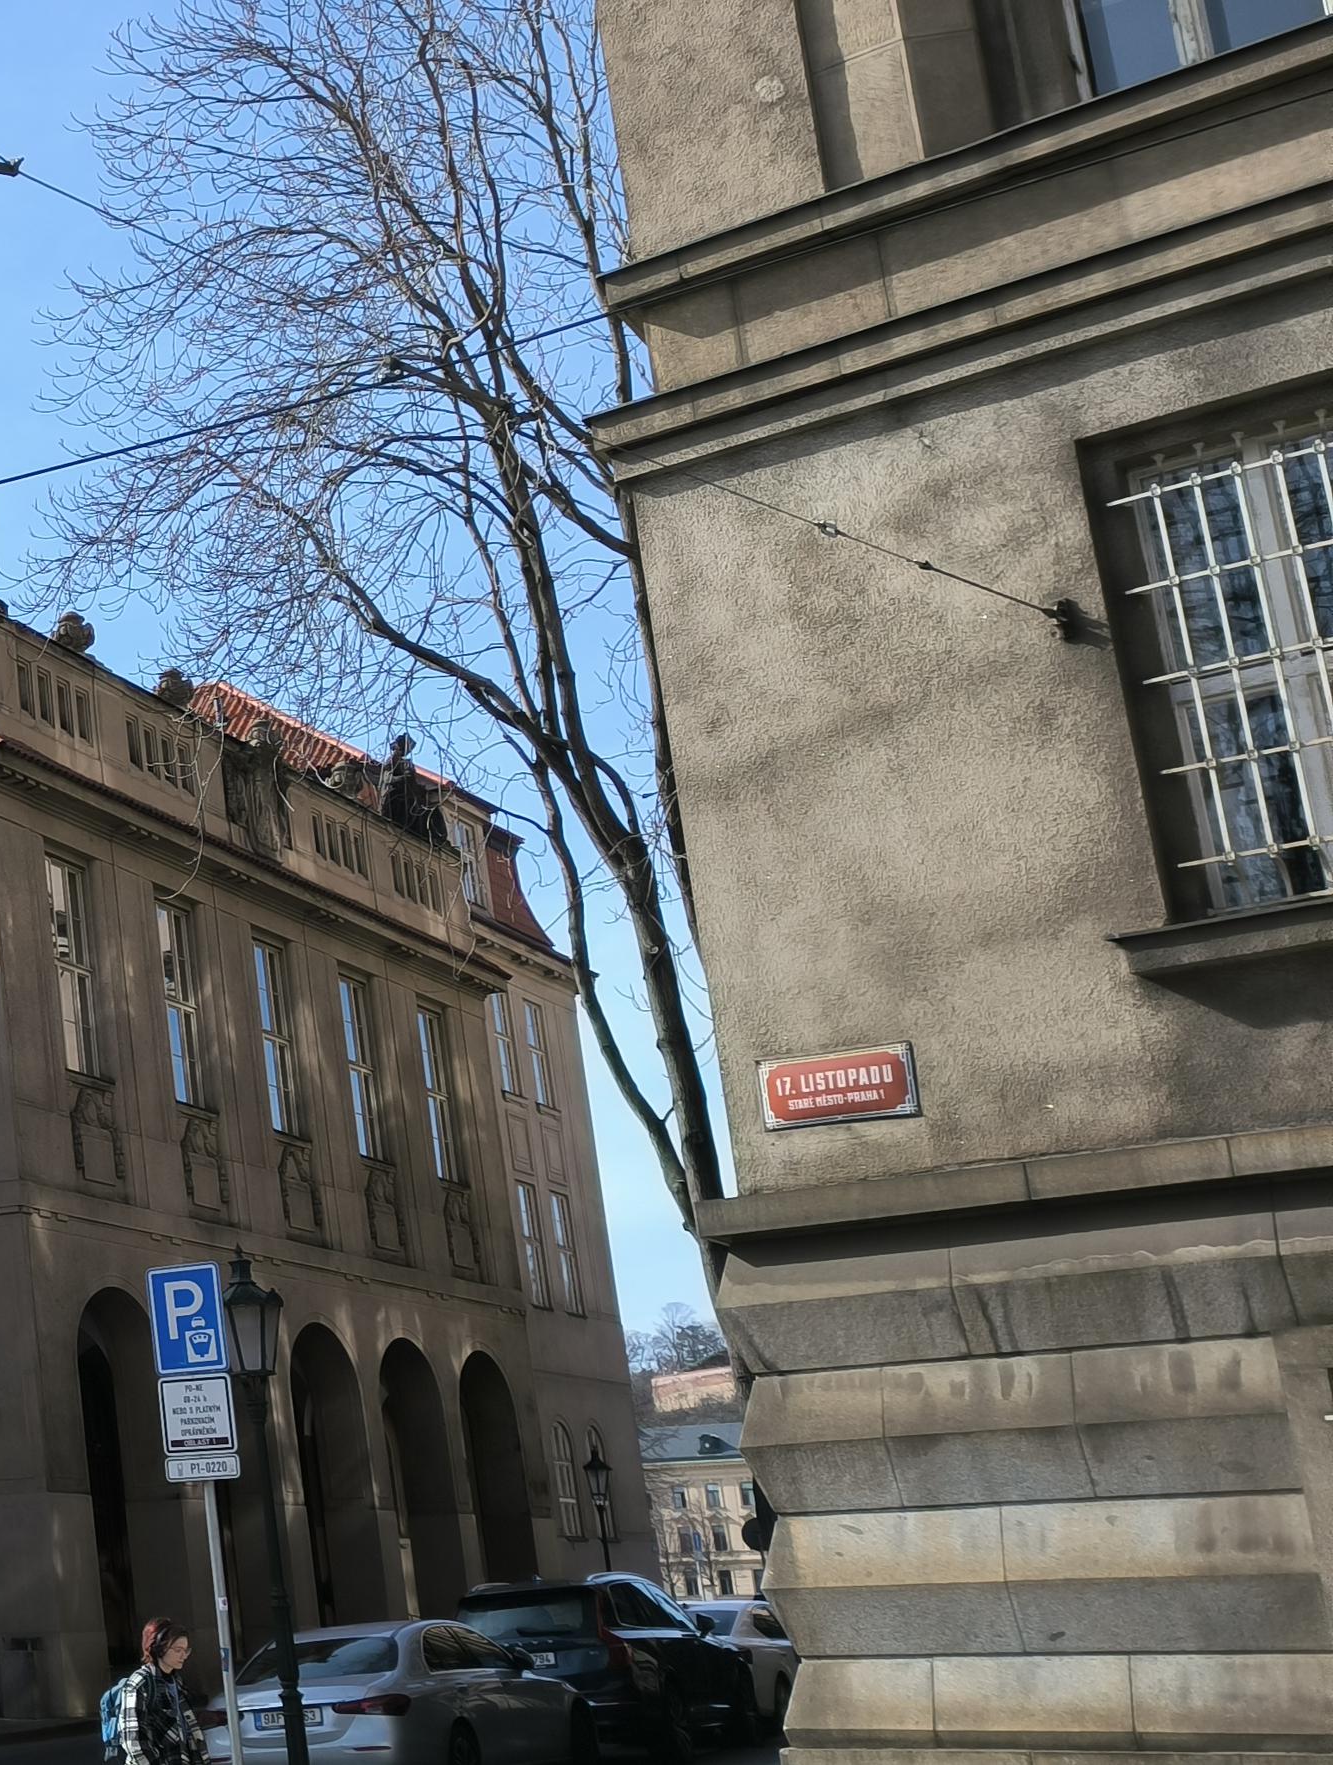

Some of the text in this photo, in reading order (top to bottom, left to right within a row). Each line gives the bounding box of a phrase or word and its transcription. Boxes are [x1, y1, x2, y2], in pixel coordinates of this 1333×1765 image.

[775, 1063, 894, 1097] 17. LISTOPADU
[788, 1095, 816, 1111] STARÉ
[164, 1280, 204, 1340] P
[190, 1461, 228, 1475] P1-0220
